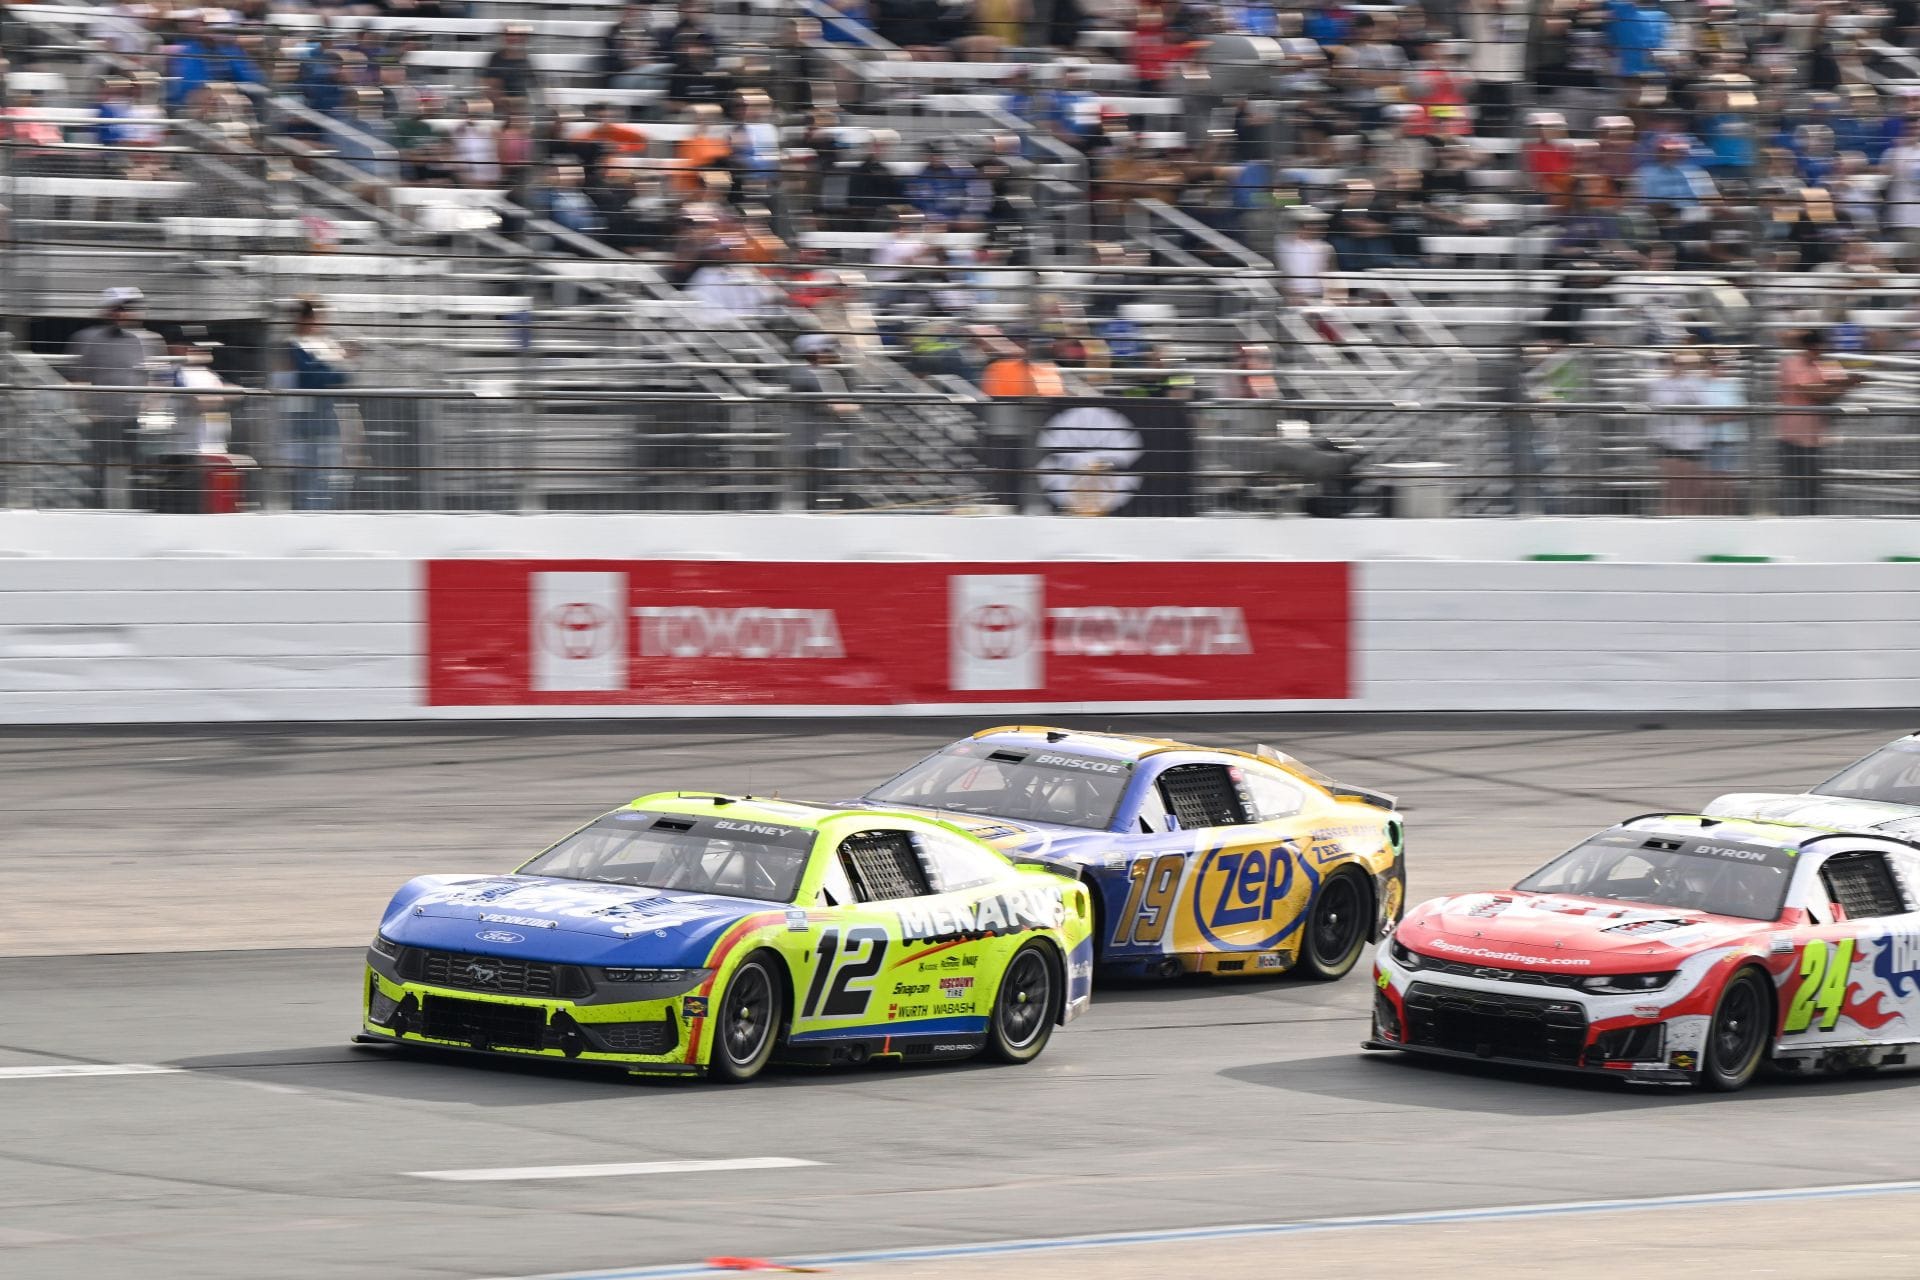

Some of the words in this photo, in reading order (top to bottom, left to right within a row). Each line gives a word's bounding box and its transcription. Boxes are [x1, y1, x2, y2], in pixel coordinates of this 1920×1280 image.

[632, 606, 848, 658] TOYOTA
[1047, 606, 1255, 656] TOYOTA
[1035, 754, 1121, 774] BRISCOE
[714, 820, 793, 837] BLANEY
[1693, 845, 1767, 861] BYRON
[1111, 852, 1185, 947] 19
[899, 887, 1065, 940] MENARDS
[1429, 938, 1591, 965] RaptorCoatings.com
[800, 925, 889, 1020] 12
[940, 977, 974, 989] DISCOUNT
[947, 989, 963, 997] TIRE
[1783, 938, 1856, 1035] 24
[933, 1002, 976, 1015] WABASH
